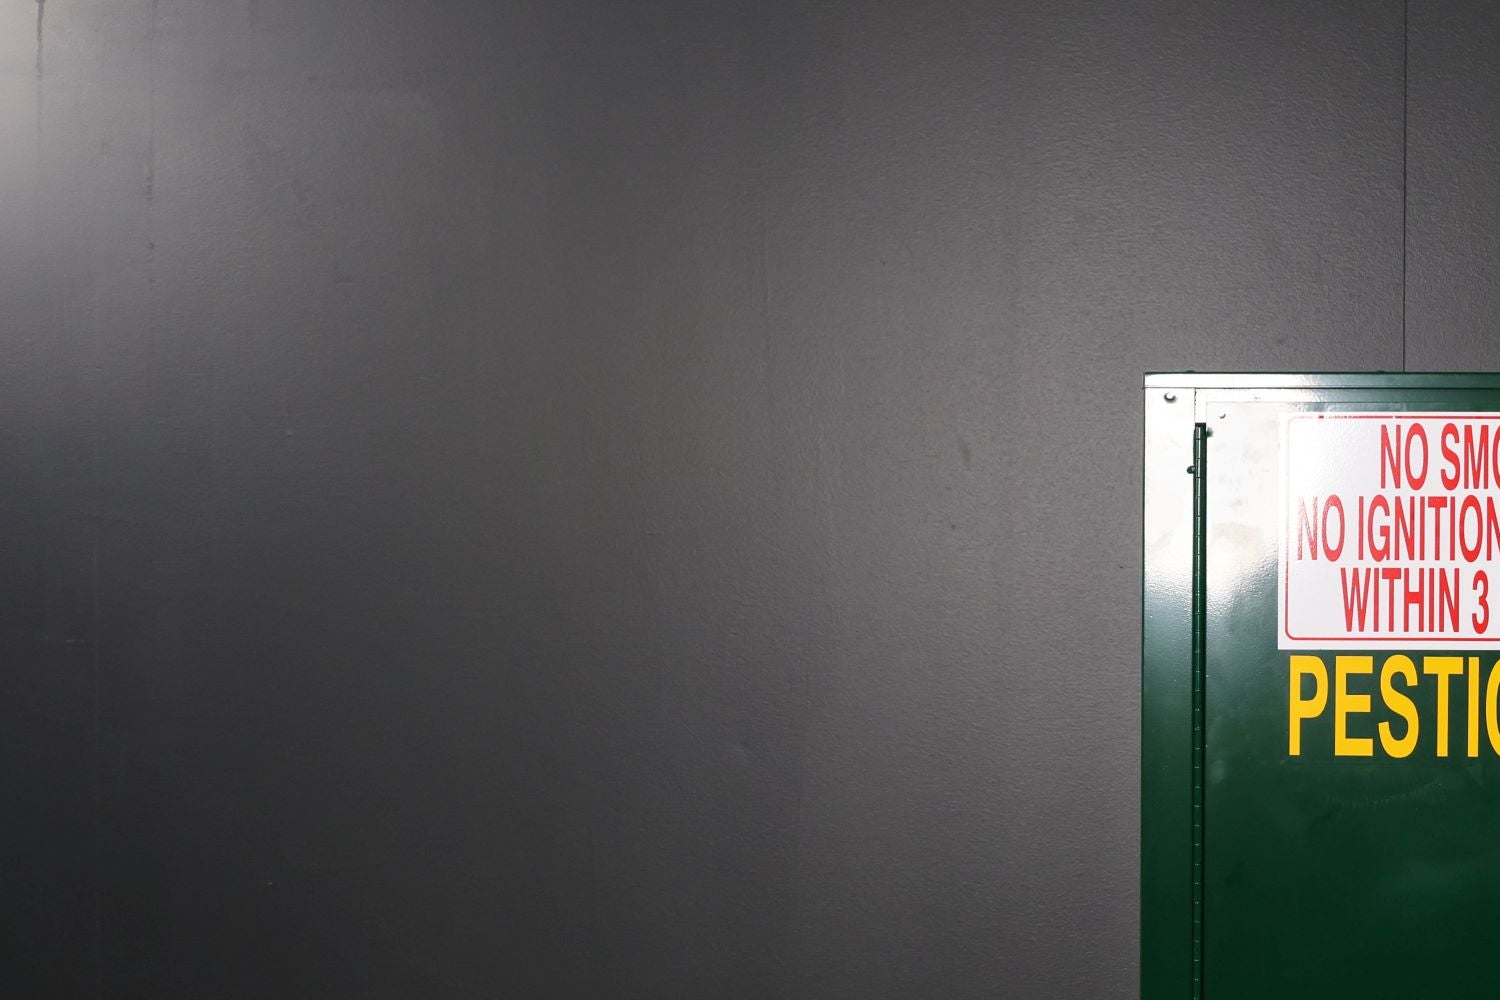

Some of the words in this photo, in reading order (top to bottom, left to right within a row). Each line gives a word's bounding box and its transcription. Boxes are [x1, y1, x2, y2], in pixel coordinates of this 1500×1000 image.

[1380, 423, 1429, 491] NO
[1297, 494, 1345, 563] NO
[1341, 567, 1460, 634] WITHIN
[1472, 569, 1489, 635] 3
